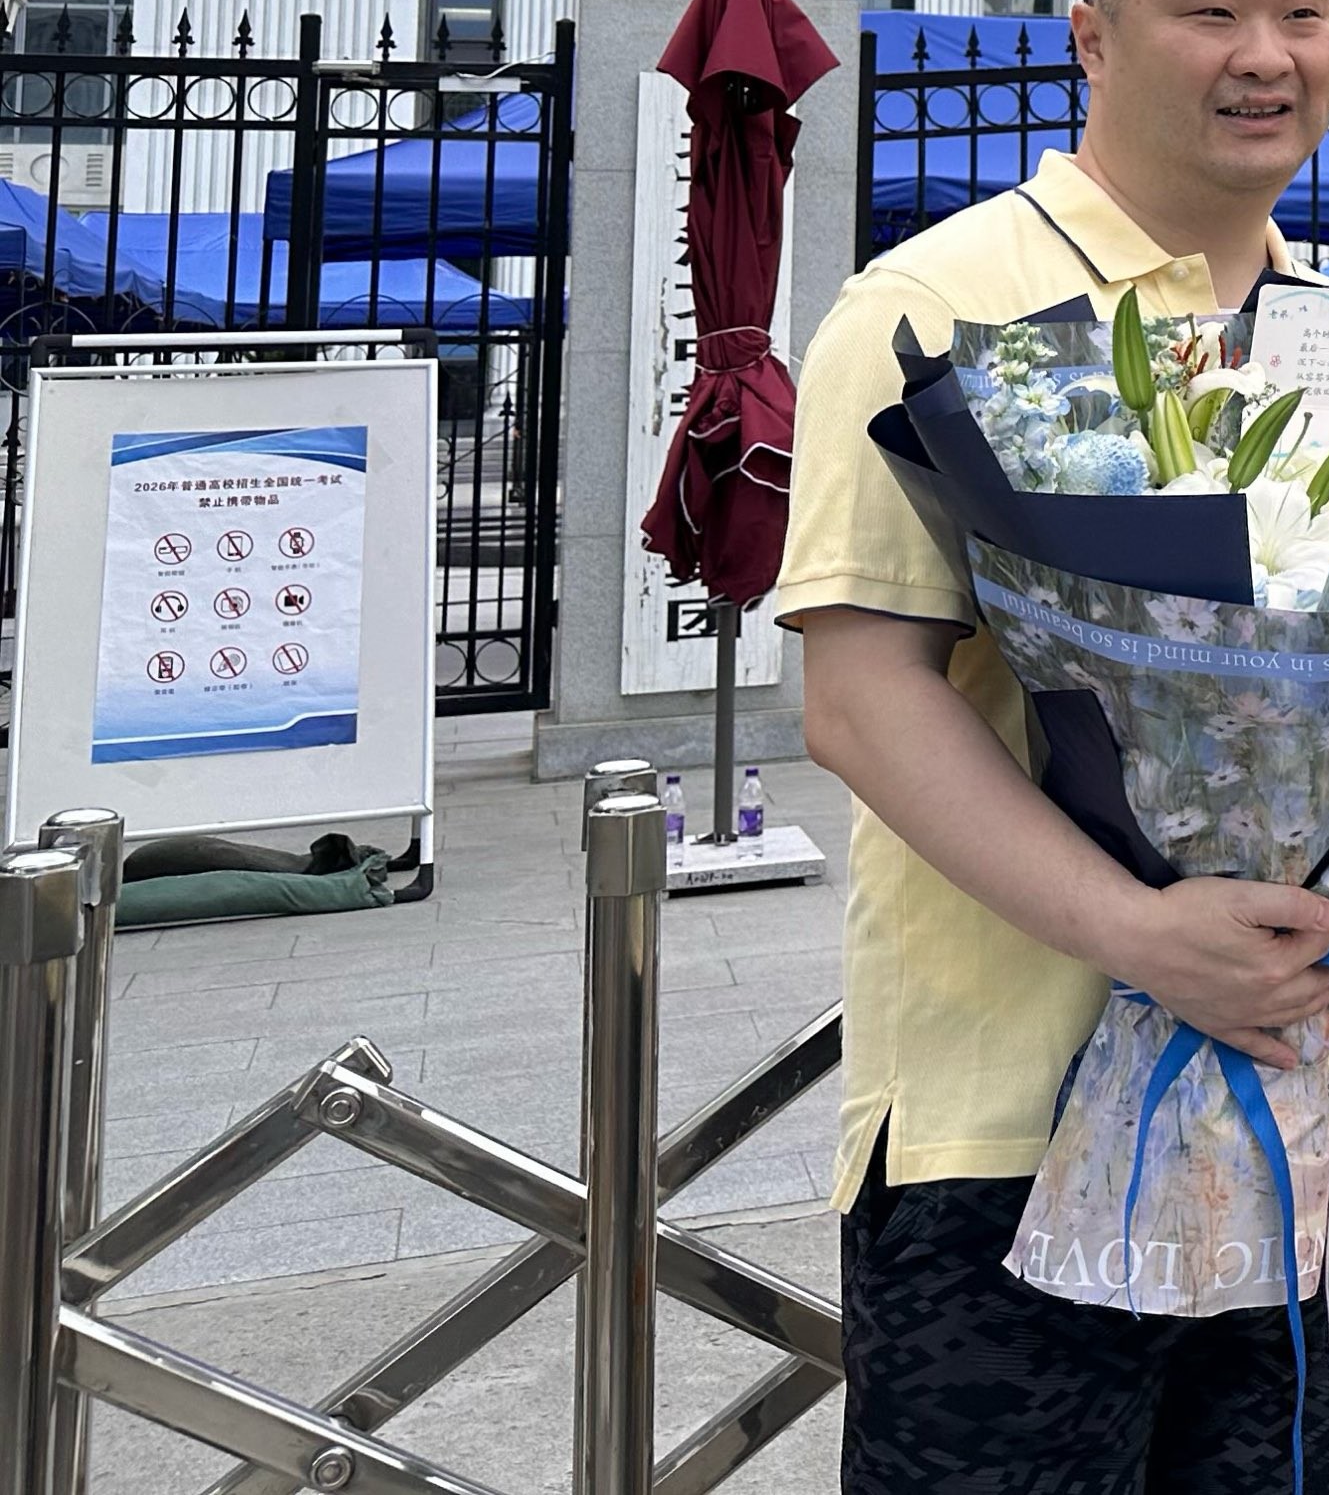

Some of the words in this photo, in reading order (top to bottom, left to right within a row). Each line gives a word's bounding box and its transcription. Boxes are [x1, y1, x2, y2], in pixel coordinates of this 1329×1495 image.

[1000, 591, 1085, 644] beautiful
[1090, 630, 1113, 648] so
[1121, 637, 1139, 659] is
[1147, 642, 1212, 667] mind
[1221, 651, 1281, 670] your
[1290, 657, 1314, 678] in
[1024, 1230, 1183, 1290] LOVE
